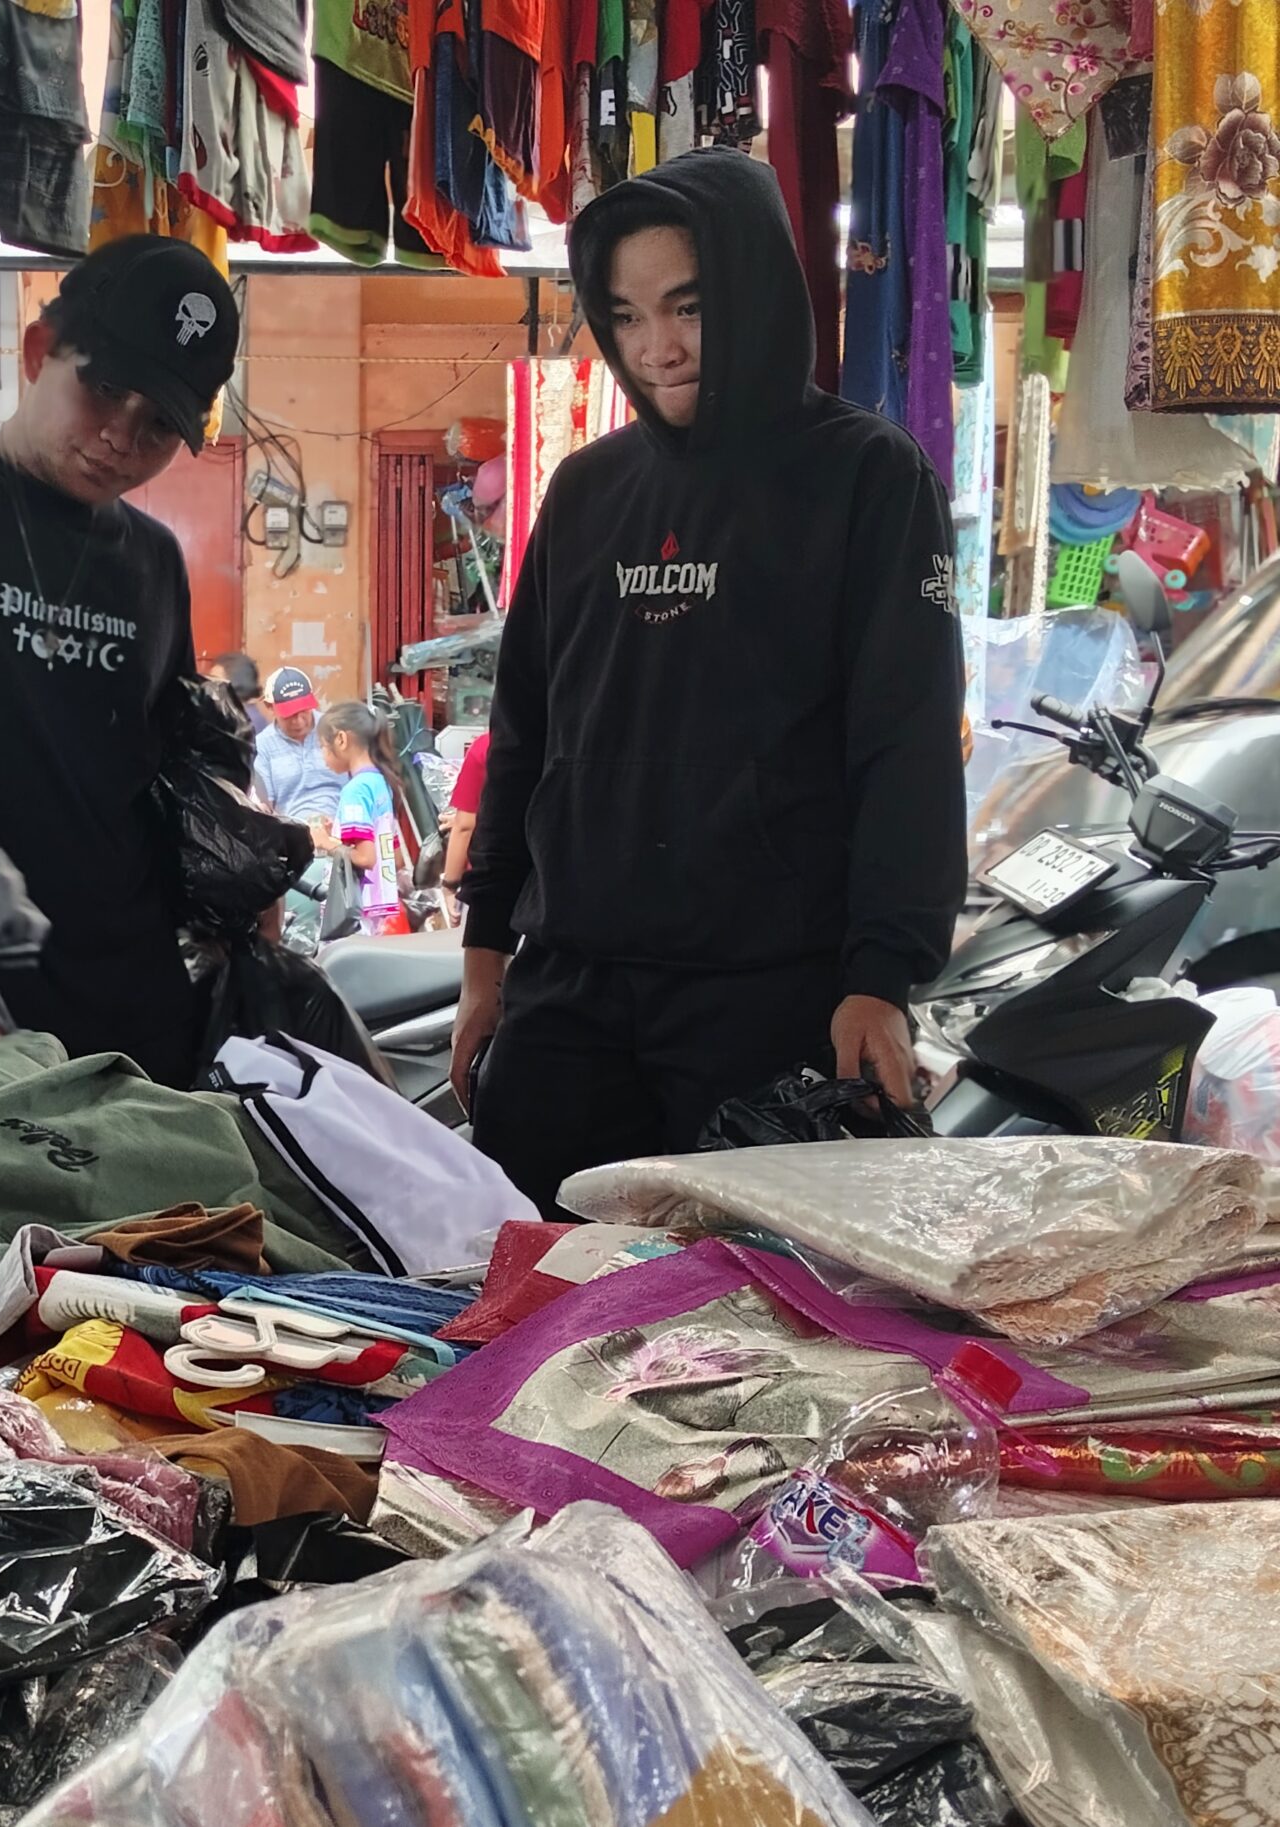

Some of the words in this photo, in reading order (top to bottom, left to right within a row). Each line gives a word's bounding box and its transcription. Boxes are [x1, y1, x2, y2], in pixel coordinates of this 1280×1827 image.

[616, 561, 718, 600] VOLCOM
[644, 602, 691, 623] STONE
[1159, 801, 1197, 825] HONDA
[1037, 845, 1083, 873] 2932
